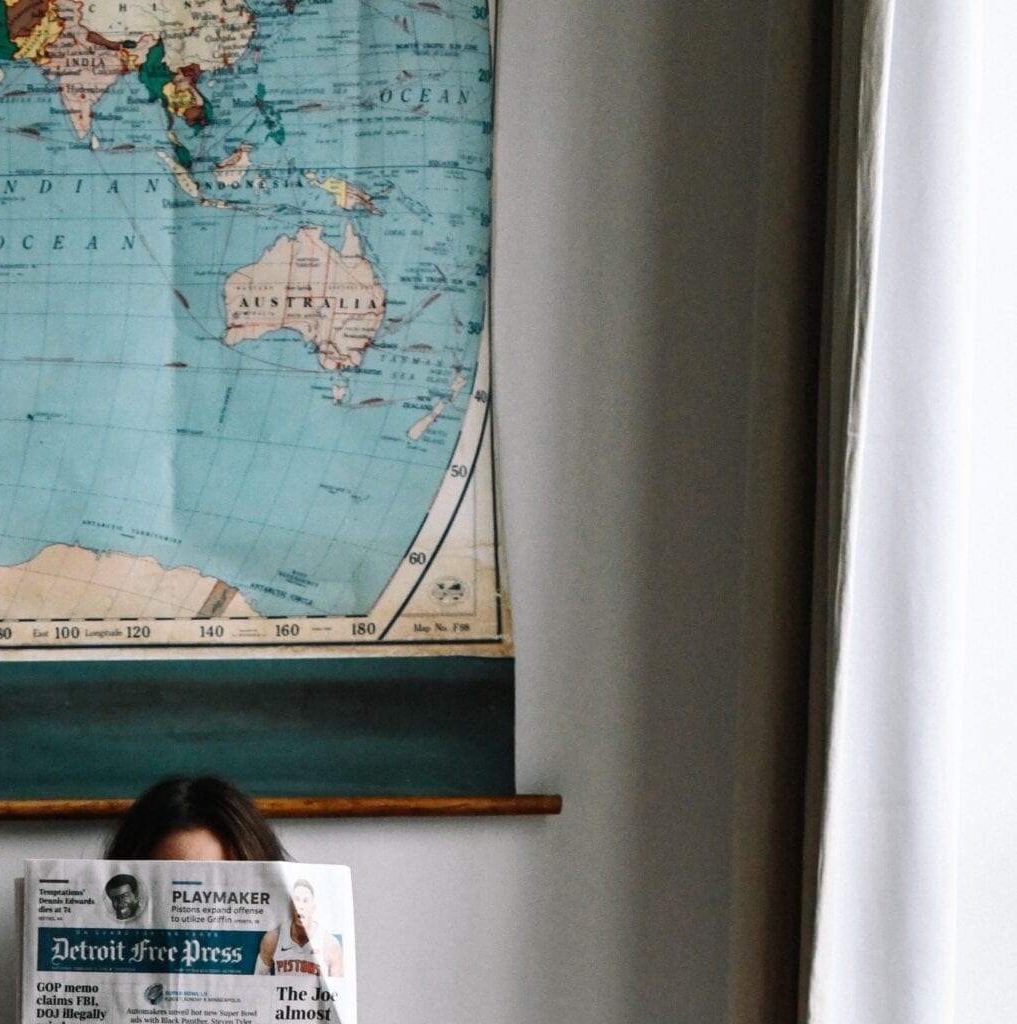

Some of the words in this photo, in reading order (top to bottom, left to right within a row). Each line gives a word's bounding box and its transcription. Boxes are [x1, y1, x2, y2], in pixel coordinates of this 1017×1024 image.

[66, 58, 105, 67] INDIA
[380, 88, 470, 104] OCEAN
[239, 298, 378, 309] AUSTRALIA
[450, 465, 467, 477] 50
[409, 552, 426, 565] 60
[54, 626, 80, 639] 100
[126, 625, 151, 639] 120
[200, 625, 224, 638] 140
[276, 624, 300, 637] 160
[351, 623, 376, 636] 180
[172, 890, 270, 905] PLAYMAKER
[172, 906, 200, 914] Pistons
[202, 907, 232, 915] expand
[233, 907, 264, 915] offense
[181, 915, 205, 923] utilize
[207, 915, 232, 923] Griffin
[51, 937, 125, 965] Detroit
[128, 939, 177, 963] Free
[181, 939, 243, 966] Press
[37, 982, 62, 993] GOP
[64, 984, 99, 993] memo
[277, 986, 307, 1001] The
[312, 987, 338, 1002] Joe
[37, 995, 73, 1006] claims
[76, 996, 99, 1007] FBI,
[36, 1008, 59, 1019] DOJ
[63, 1008, 107, 1021] illegally
[126, 1008, 168, 1016] Automakers
[169, 1008, 189, 1016] unveil
[220, 1010, 239, 1018] Super
[275, 1006, 332, 1021] almost
[130, 1016, 142, 1024] ads
